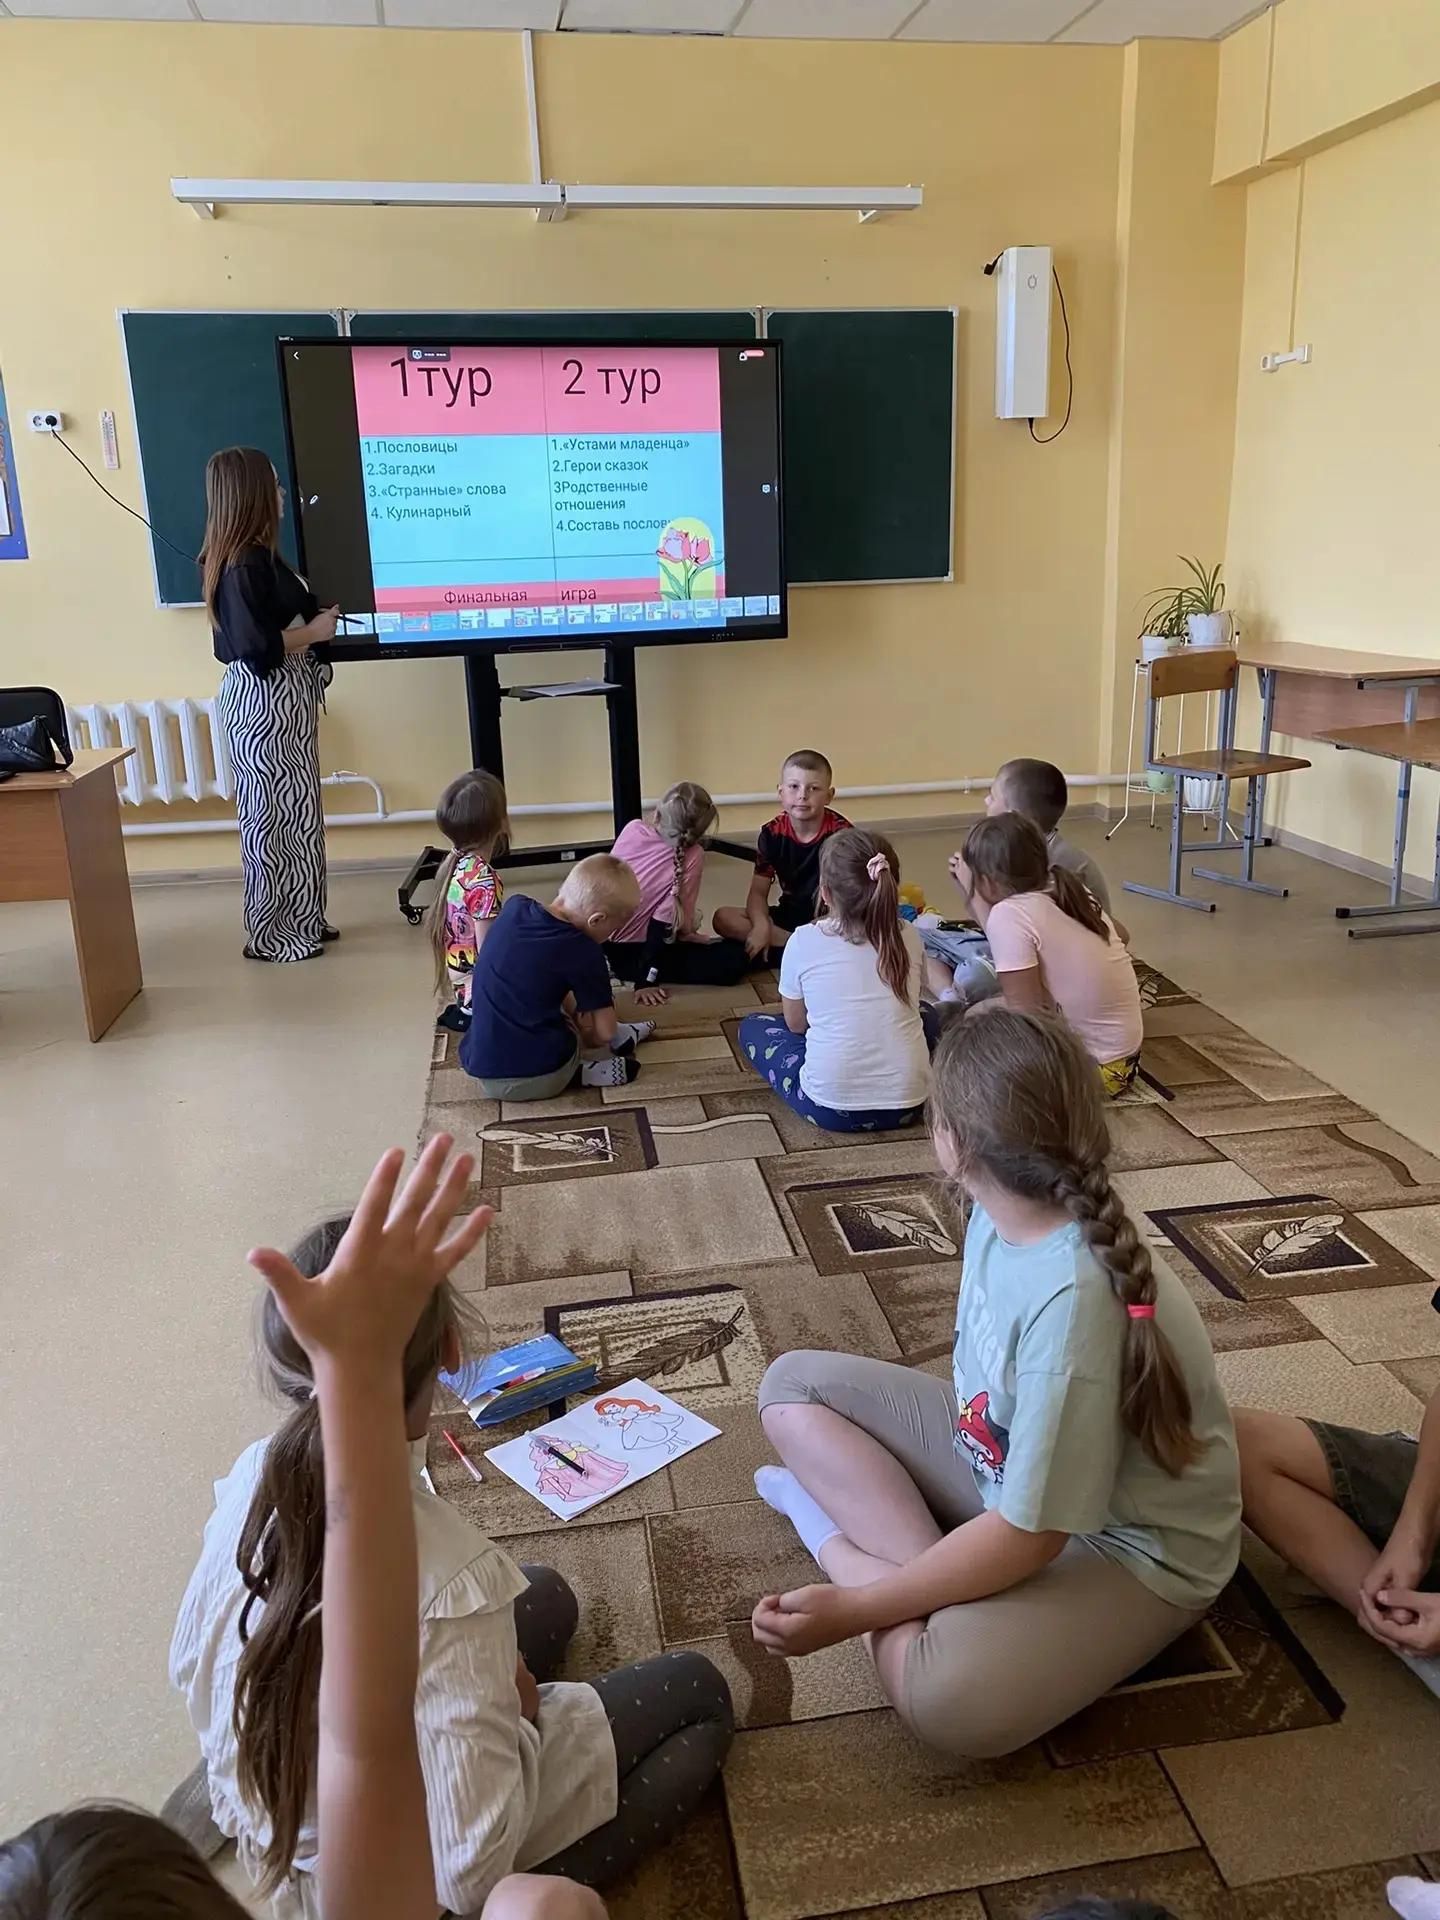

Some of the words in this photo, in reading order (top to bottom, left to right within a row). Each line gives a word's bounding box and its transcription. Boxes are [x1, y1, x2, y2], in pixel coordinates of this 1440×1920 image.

[562, 359, 586, 395] 2
[597, 367, 662, 405] тур
[364, 441, 458, 454] 1.Пословицы
[551, 438, 617, 451] 1.«Устами
[620, 439, 690, 451] младенца»
[366, 463, 436, 477] 2.Загадки
[552, 460, 602, 474] 2.Герои
[604, 460, 649, 471] сказок
[368, 484, 463, 499] 3.«Странные»
[466, 484, 507, 496] слова
[553, 481, 649, 494] 3Родственные
[554, 499, 626, 511] отношения
[386, 505, 472, 521] Кулинарный
[556, 519, 620, 532] 4.Составь
[623, 519, 671, 530] послов
[444, 590, 528, 604] Финальная
[561, 588, 597, 603] игра
